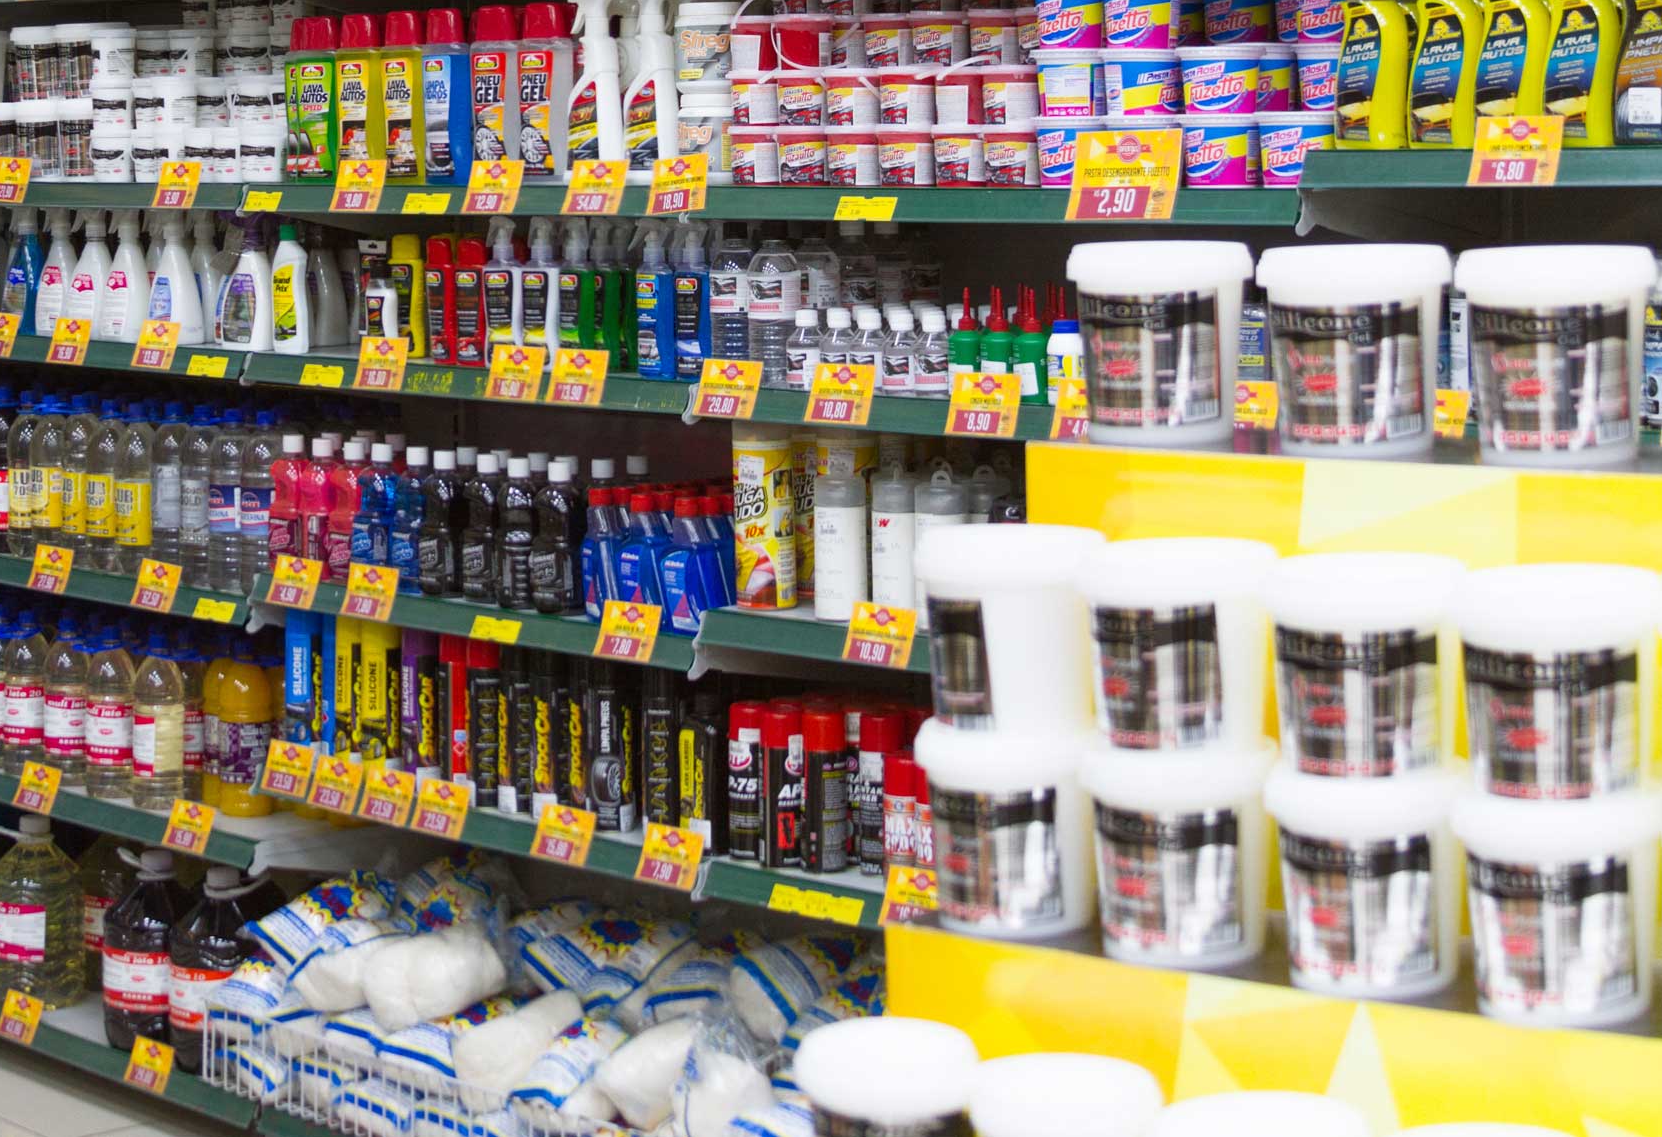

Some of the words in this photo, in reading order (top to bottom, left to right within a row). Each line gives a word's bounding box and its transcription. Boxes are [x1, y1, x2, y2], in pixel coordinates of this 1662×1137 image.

[1039, 0, 1061, 12] ROSA
[1038, 12, 1083, 34] uzetto
[680, 30, 731, 55] Sfreg
[1345, 42, 1374, 53] LAVA
[1422, 42, 1458, 55] LAVA
[1486, 36, 1521, 50] LAVA
[1555, 34, 1592, 48] LAVA
[1341, 50, 1379, 63] AUTOS
[1417, 52, 1462, 66] AUTOS
[1481, 46, 1525, 61] AUTOS
[1551, 43, 1596, 59] AUTOS
[1625, 44, 1662, 59] PNEU
[1196, 62, 1224, 76] ROSA
[1305, 63, 1328, 76] ROSA
[342, 80, 363, 91] LAVA
[387, 79, 407, 90] LAVA
[475, 75, 500, 87] PNEU
[521, 73, 547, 86] PNEU
[1189, 74, 1244, 101] Fuzetto
[303, 84, 324, 94] LAVA
[340, 89, 367, 102] AUTOS
[385, 87, 411, 101] AUTOS
[475, 86, 501, 103] GEL
[521, 85, 548, 102] GEL
[1301, 76, 1336, 100] Fuzet
[300, 92, 328, 104] AUTOS
[677, 124, 712, 146] freg
[1275, 129, 1301, 144] ROSA
[1084, 167, 1101, 177] PASTA
[1147, 166, 1171, 177] FUZETTO
[1495, 162, 1525, 182] 6,80
[662, 191, 684, 209] 18,90
[1097, 188, 1136, 216] 2,90
[1348, 332, 1371, 344] Gel
[710, 398, 735, 415] 29,80
[966, 412, 990, 432] 8,90
[1072, 419, 1088, 436] 4,8
[735, 502, 766, 522] UDO
[612, 637, 633, 656] 7,80
[859, 642, 886, 662] 10,90
[292, 645, 303, 697] SILICONE
[369, 660, 378, 711] SILICONE
[401, 665, 410, 717] SILICONE
[600, 699, 611, 724] PNEUS
[600, 725, 611, 753] LIMPA
[653, 861, 673, 881] 7,90
